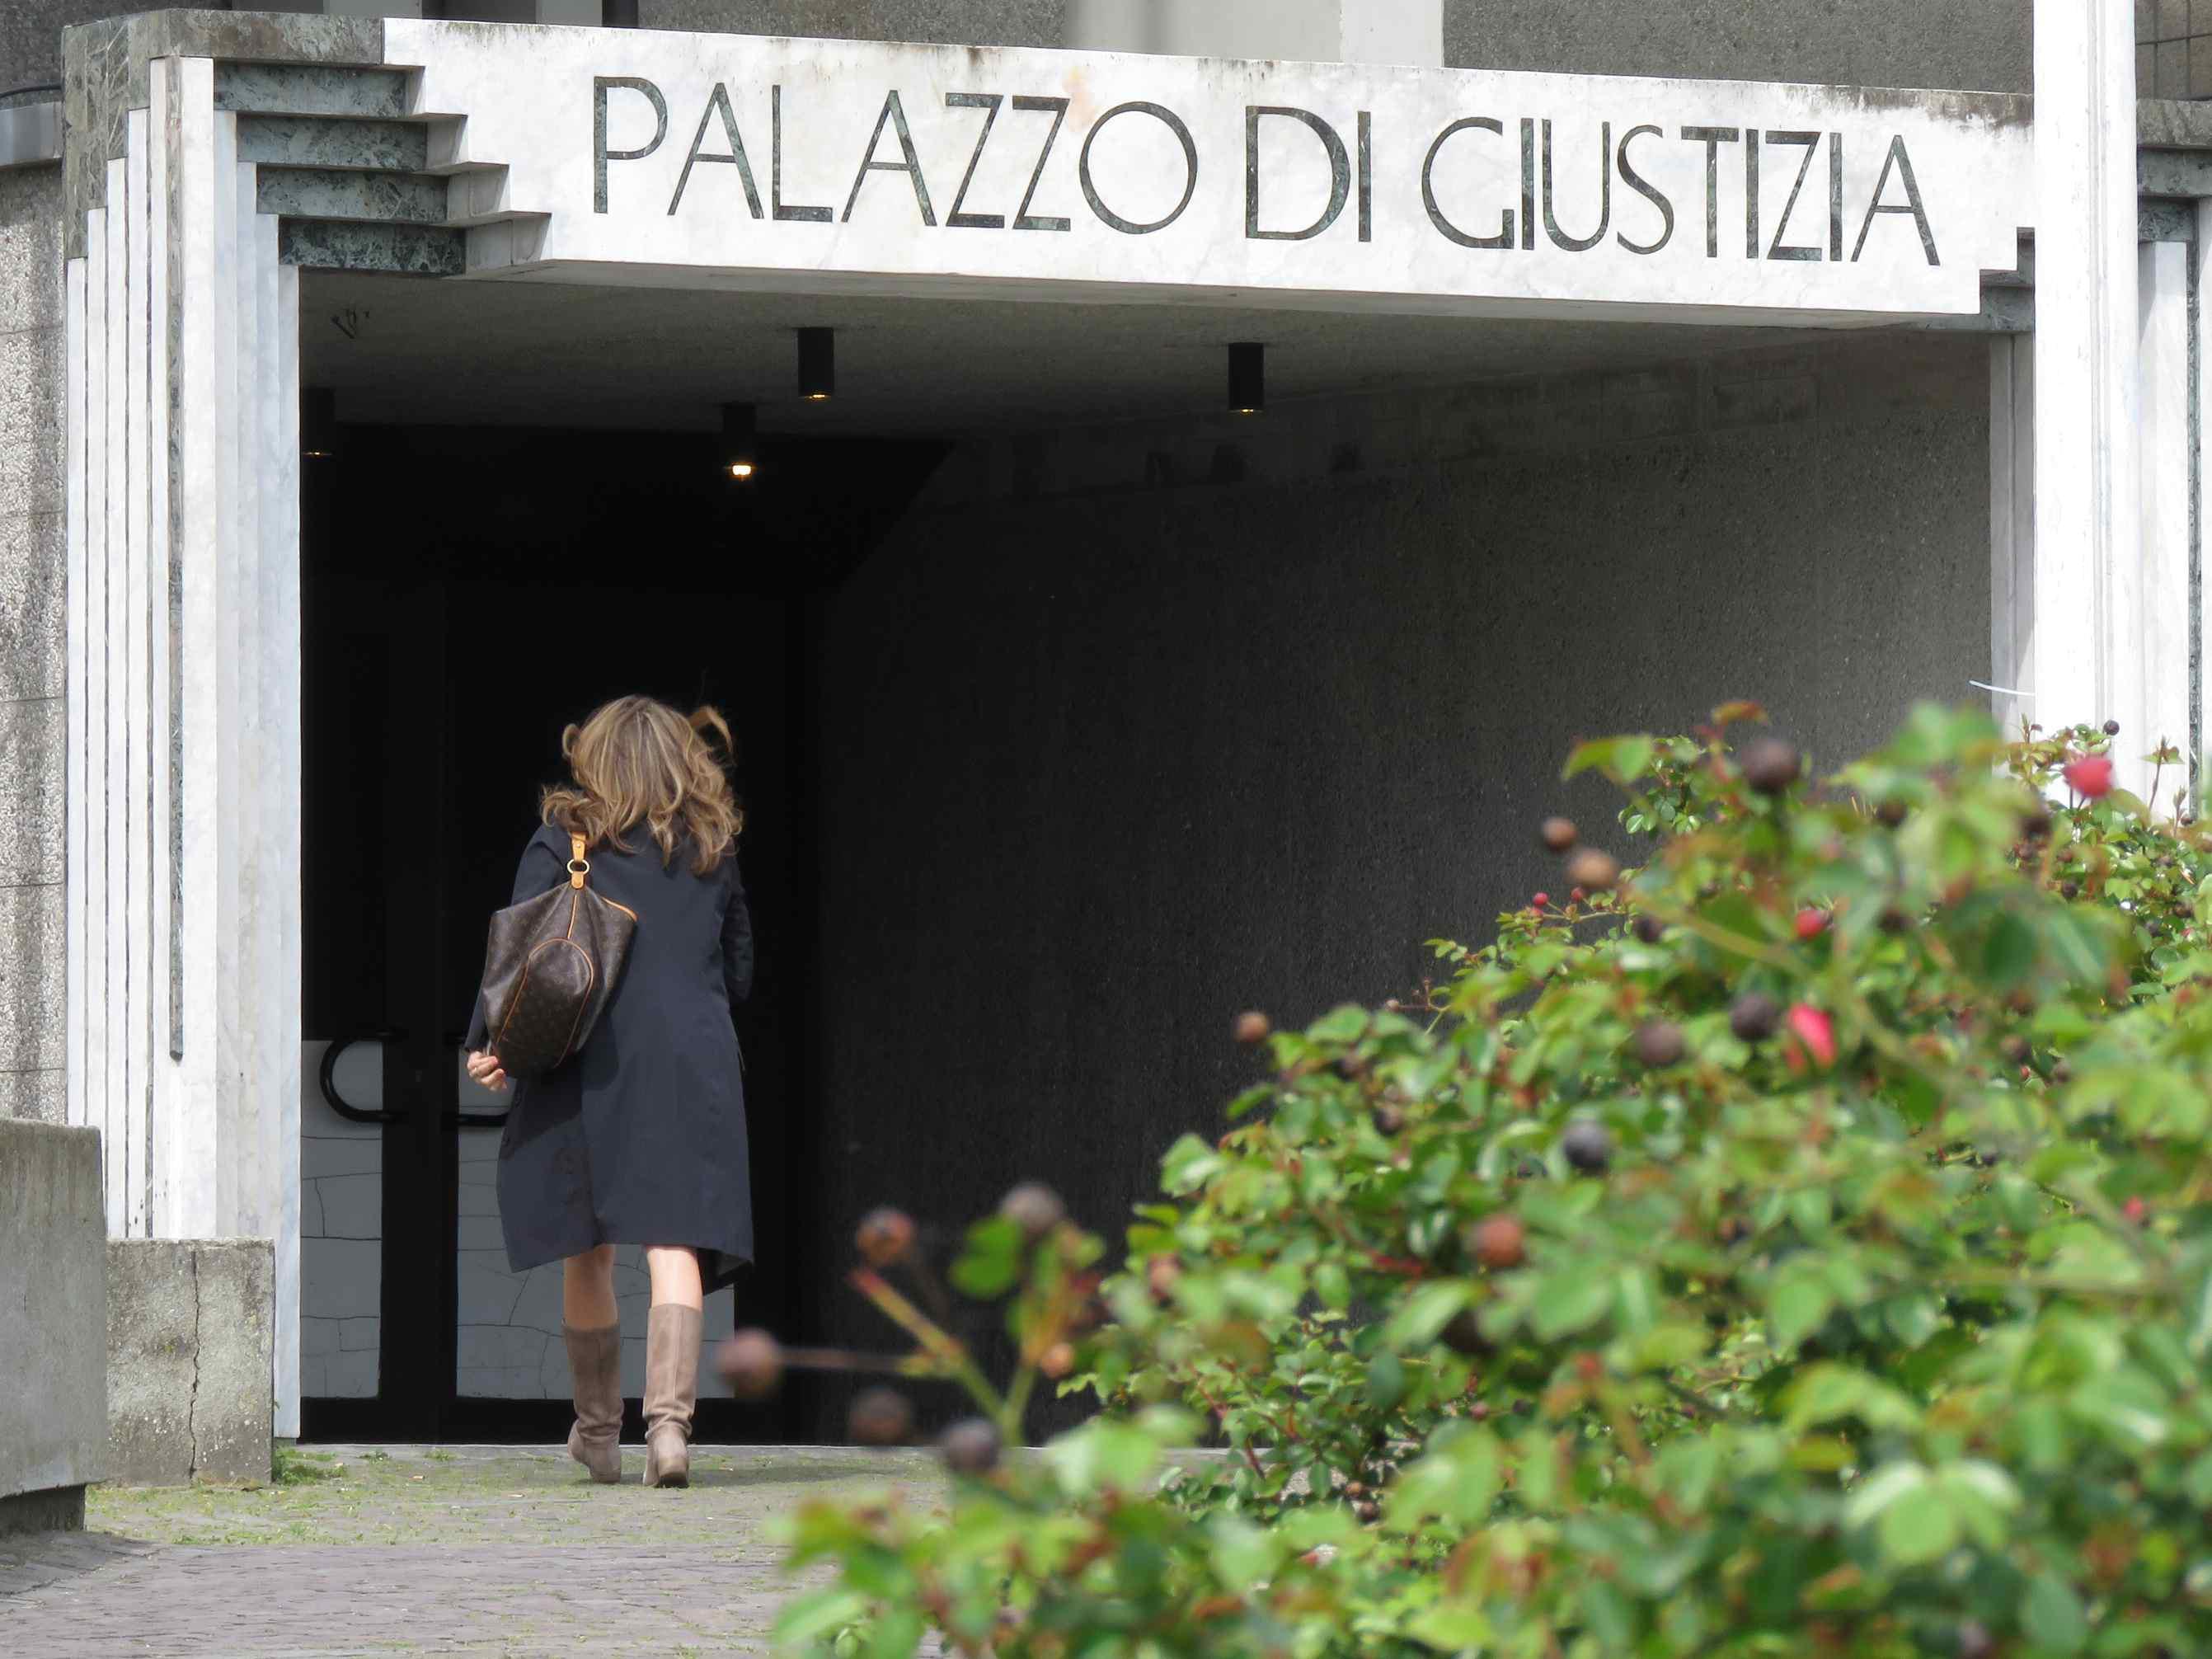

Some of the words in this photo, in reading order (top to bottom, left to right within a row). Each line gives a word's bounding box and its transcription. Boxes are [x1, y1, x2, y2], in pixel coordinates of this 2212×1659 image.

[593, 75, 1199, 235] PALAZZO
[1245, 105, 1372, 243] DI
[1421, 116, 1941, 266] GIUSTIZIA
